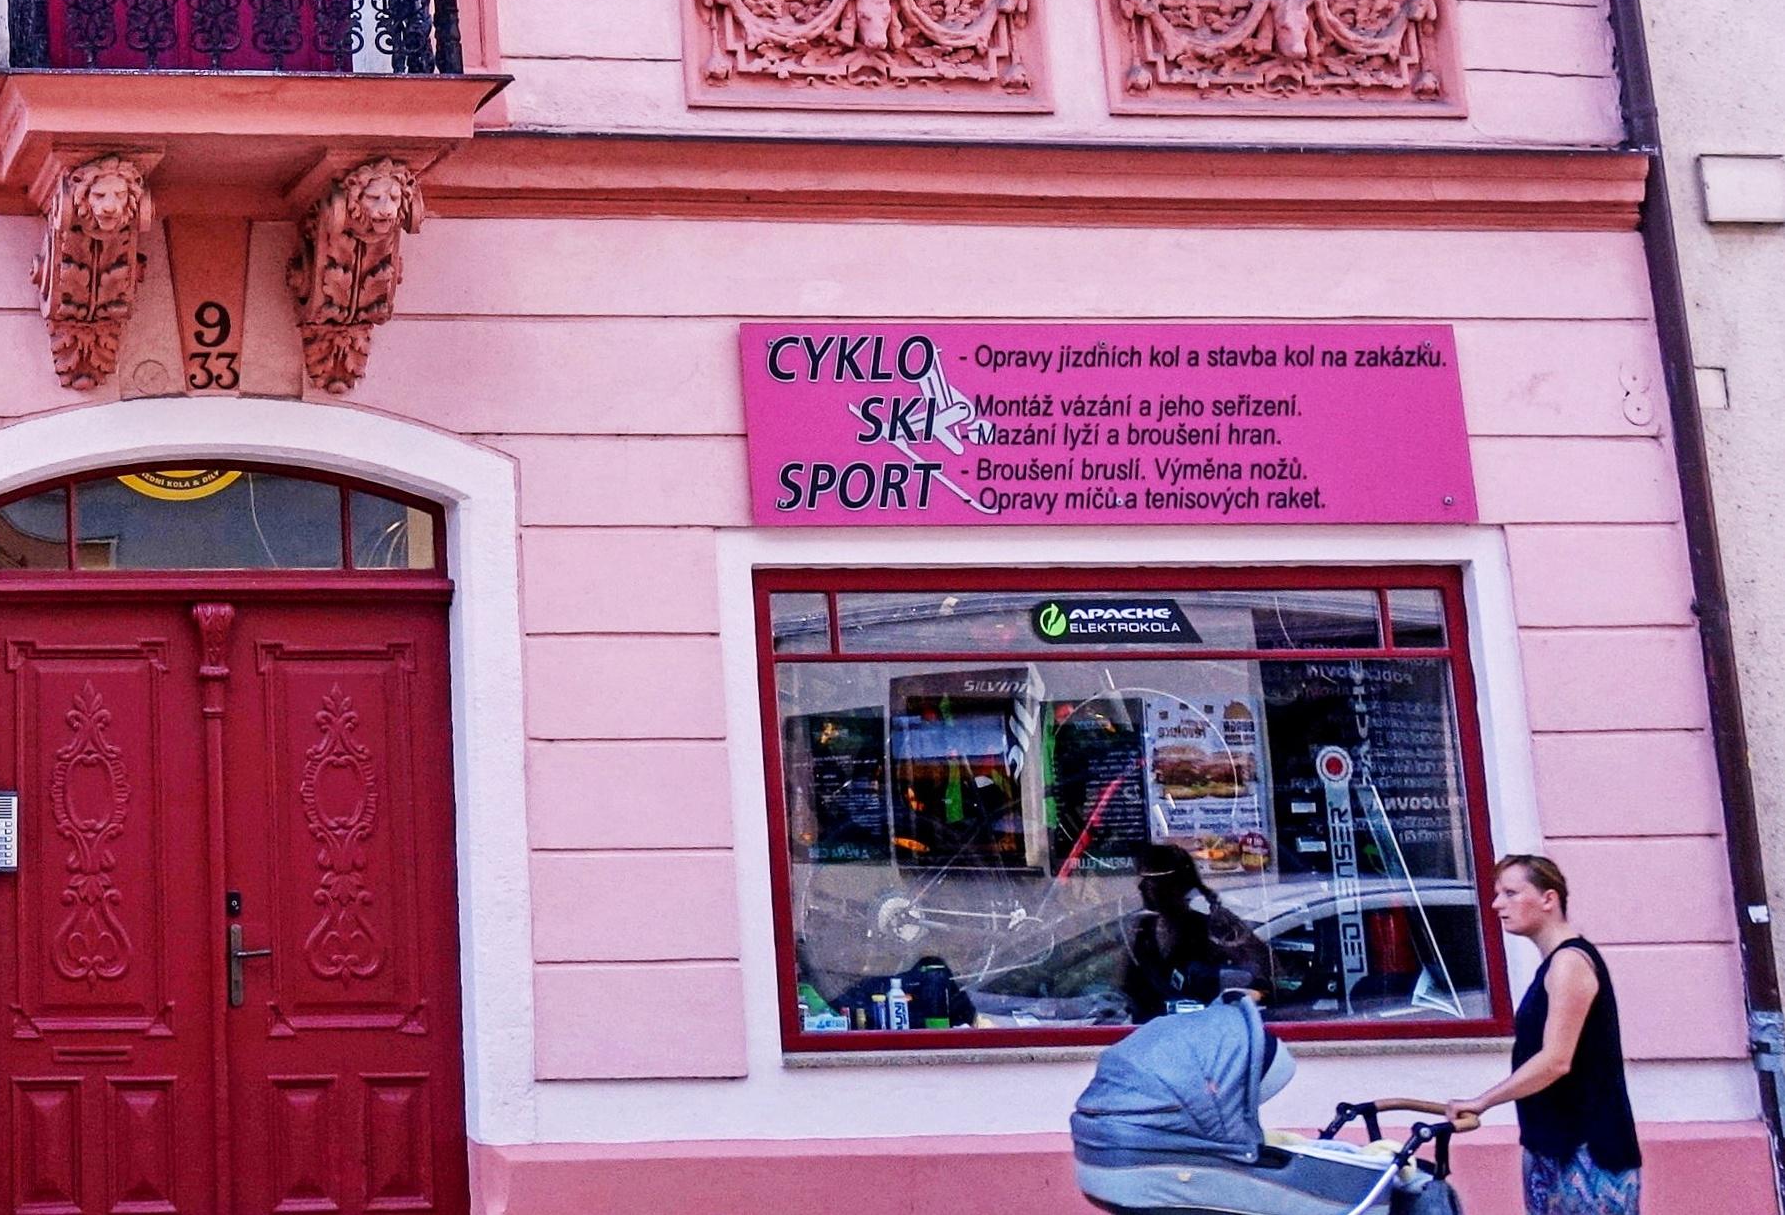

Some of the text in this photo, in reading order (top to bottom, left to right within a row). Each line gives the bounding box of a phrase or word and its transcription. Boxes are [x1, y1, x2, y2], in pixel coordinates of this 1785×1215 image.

[193, 300, 232, 348] 9
[188, 352, 240, 390] 33
[767, 334, 936, 383] CYKLO
[974, 344, 1053, 373] Opravy
[1057, 344, 1142, 373] jízdních
[1149, 344, 1180, 368] kol
[1187, 350, 1200, 368] a
[1207, 344, 1277, 368] stavba
[1284, 344, 1315, 368] kol
[1321, 349, 1347, 368] na
[1354, 344, 1447, 368] zakázku.
[857, 395, 938, 445] SKI
[974, 394, 1054, 417] Montáž
[1061, 394, 1132, 417] vázání
[1139, 399, 1151, 417] a
[1156, 394, 1205, 423] jeho
[1211, 393, 1302, 417] seřízení.
[978, 422, 1056, 446] Mazání
[1063, 422, 1100, 451] lyží
[1107, 427, 1119, 446] a
[1127, 422, 1221, 446] broušení
[1228, 422, 1282, 446] hran.
[977, 458, 1074, 481] Broušení
[1081, 457, 1146, 481] bruslí.
[1155, 457, 1242, 485] Výměna
[1250, 456, 1308, 480] nožů.
[776, 462, 943, 511] SPORT
[979, 486, 1058, 515] Opravy
[1065, 486, 1116, 510] míčů
[1124, 491, 1137, 510] a
[1145, 486, 1259, 515] tenisových
[1267, 486, 1326, 510] raket.
[1069, 608, 1172, 620] APACHE
[1069, 622, 1181, 634] ELEKTROKOLA
